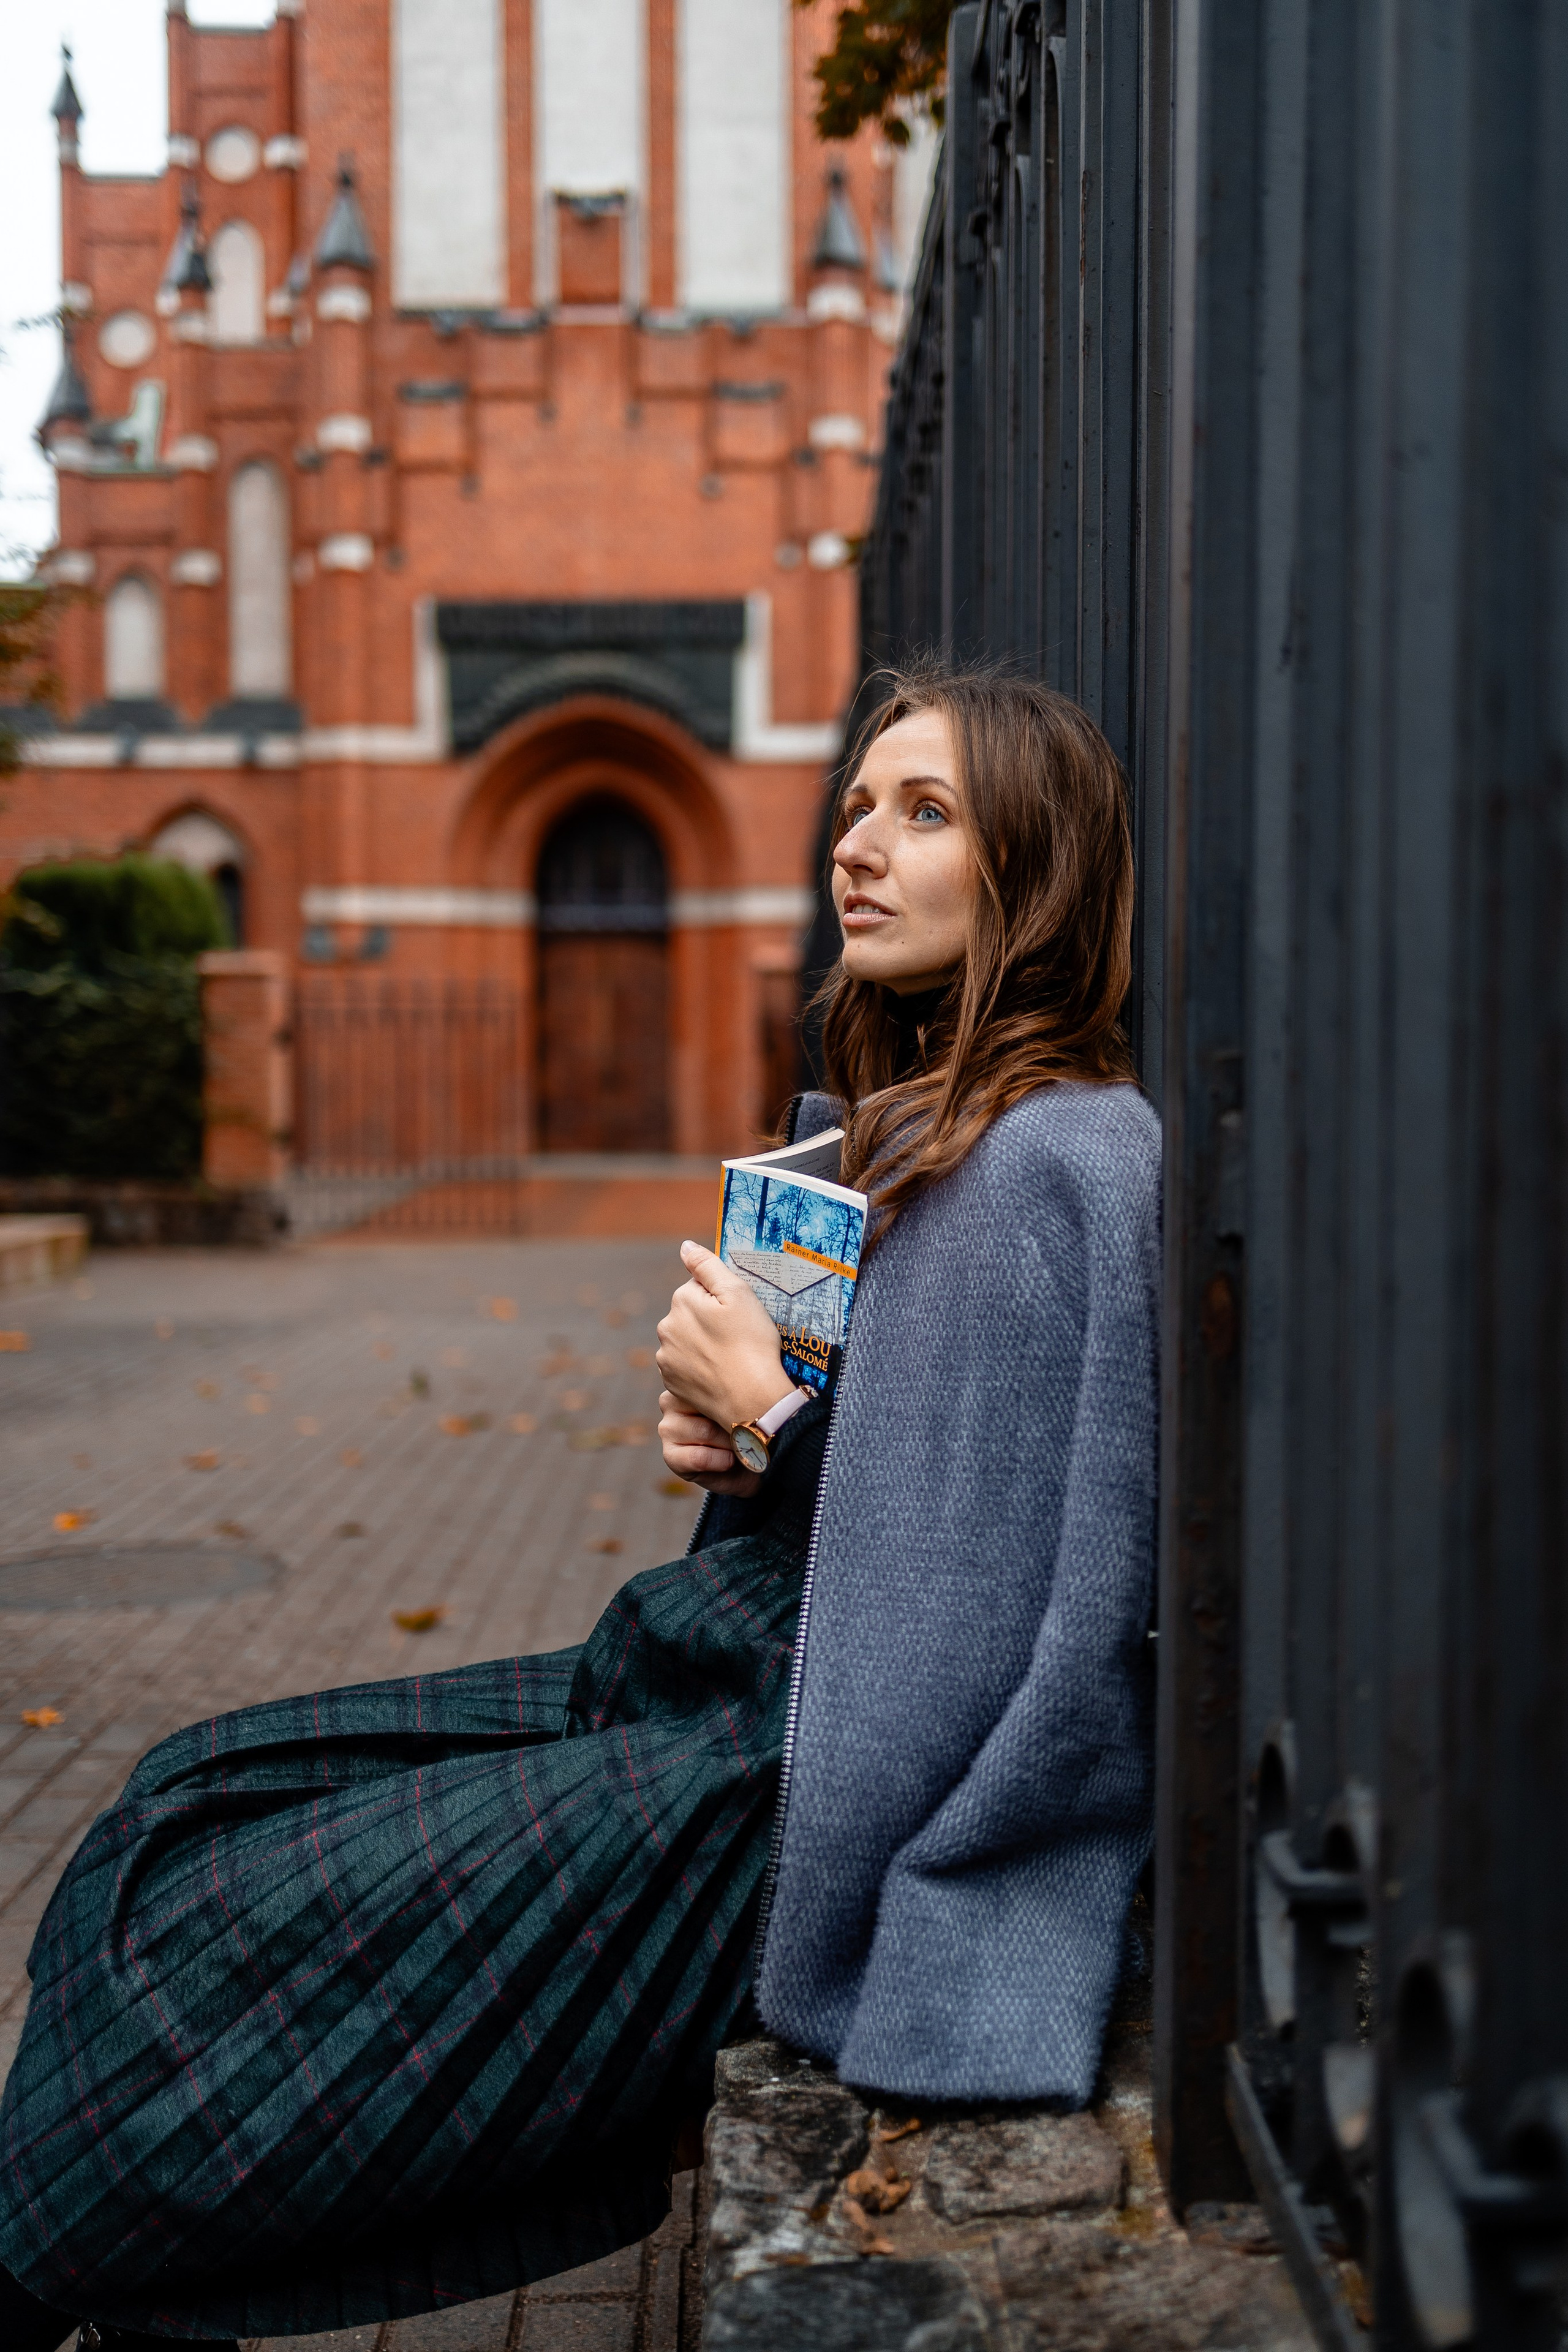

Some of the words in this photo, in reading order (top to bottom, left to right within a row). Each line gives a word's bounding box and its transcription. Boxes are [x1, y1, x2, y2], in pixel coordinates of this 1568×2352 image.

[786, 1243, 809, 1257] Rainer
[812, 1253, 831, 1268] Maria
[833, 1262, 850, 1275] Rilke
[789, 1326, 796, 1341] À
[799, 1326, 832, 1357] LOU
